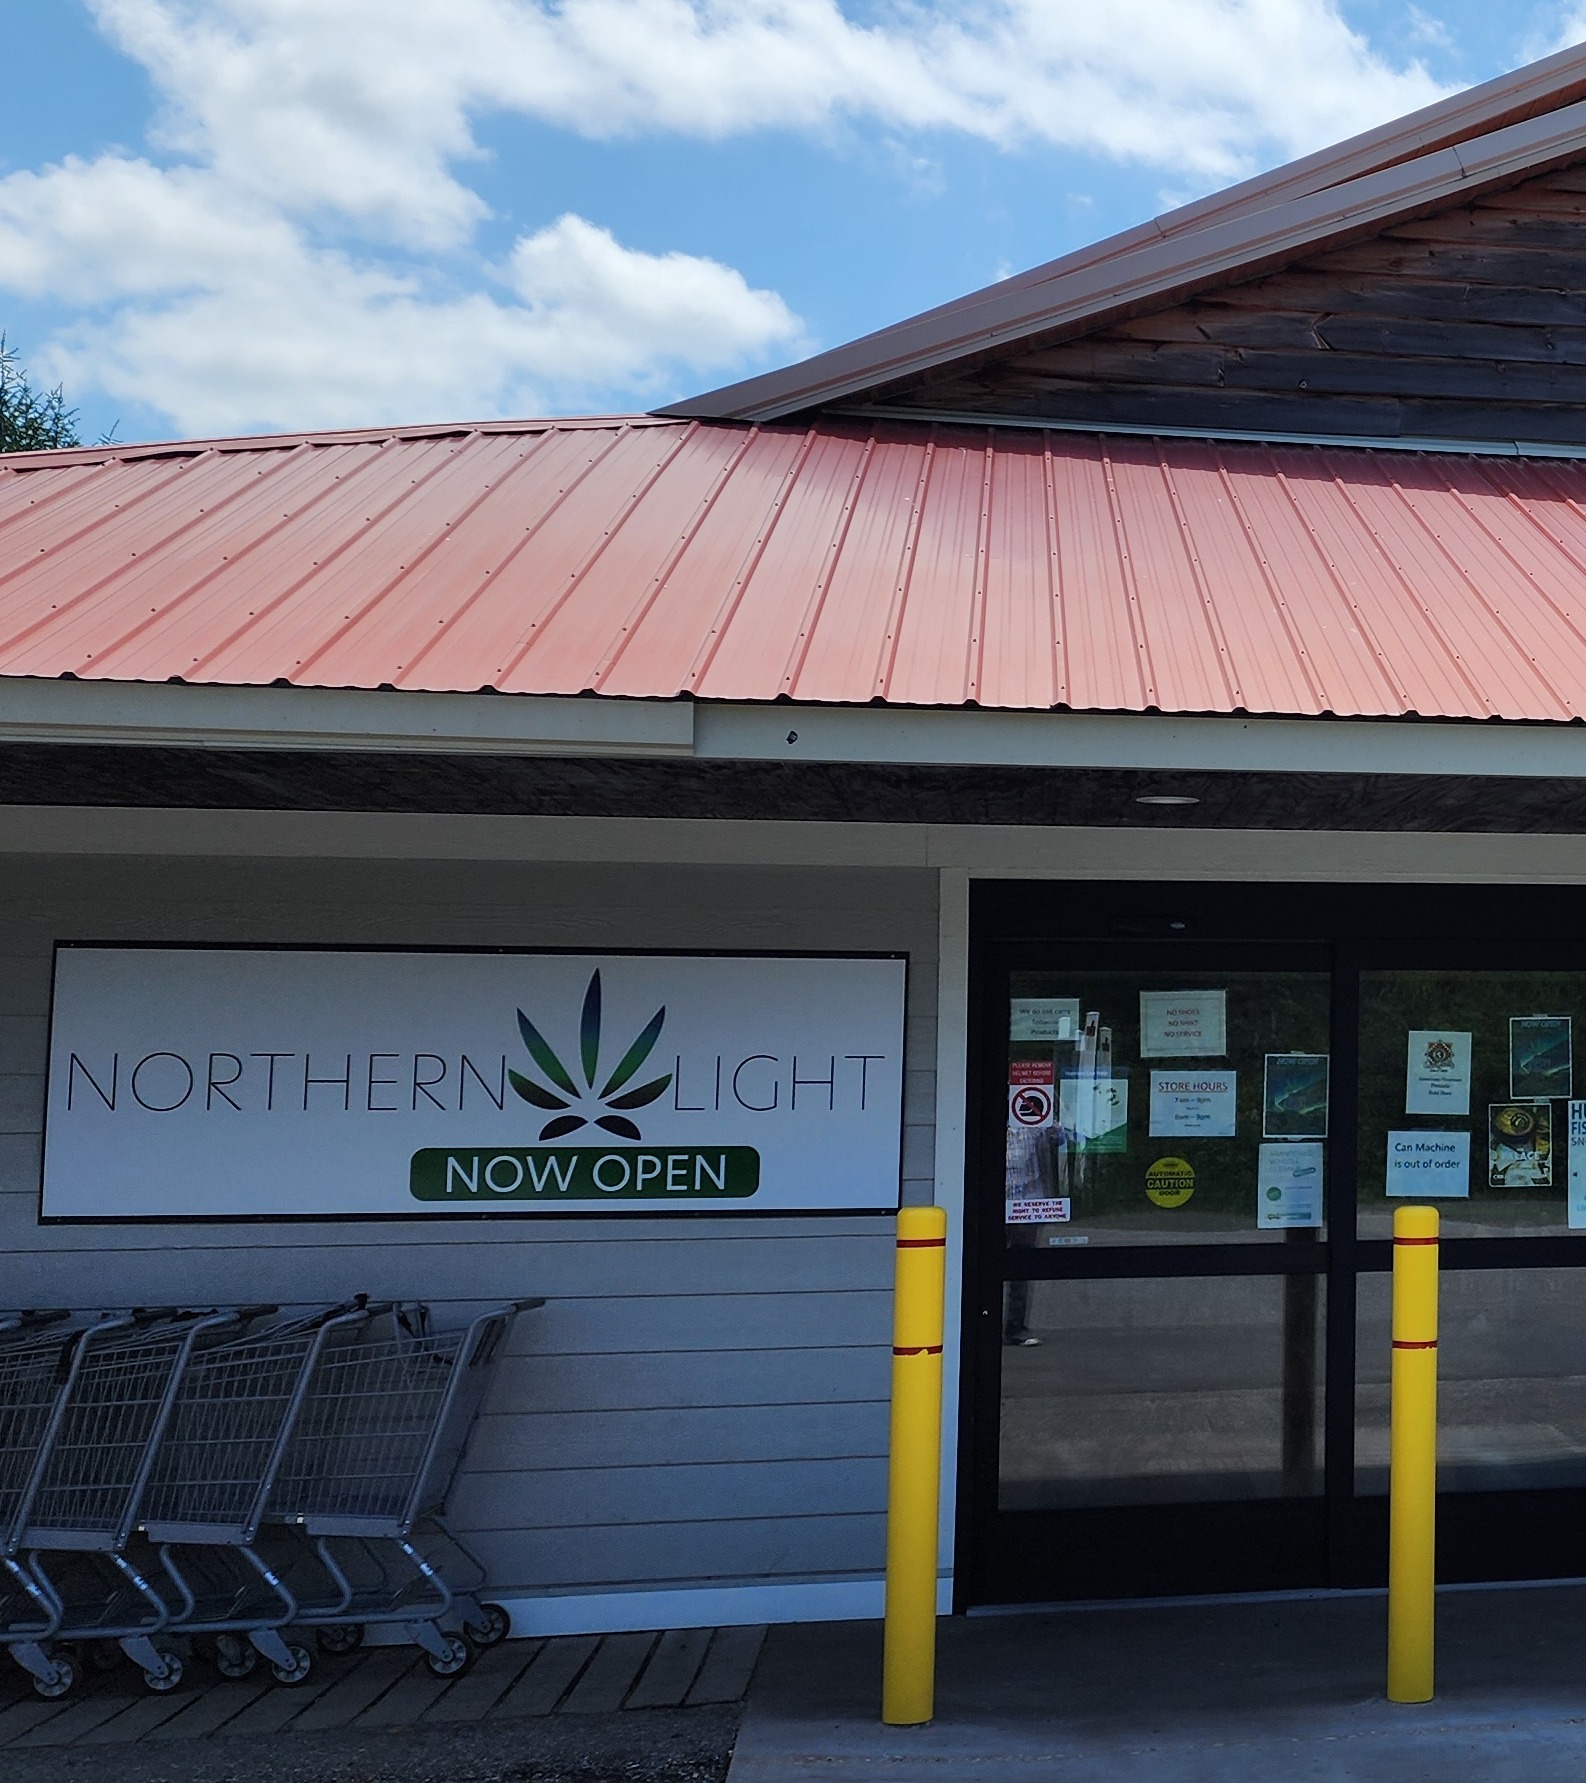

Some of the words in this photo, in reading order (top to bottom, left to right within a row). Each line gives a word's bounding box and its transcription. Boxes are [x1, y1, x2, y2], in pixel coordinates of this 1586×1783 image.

[66, 1050, 507, 1113] NORTHERN
[673, 1053, 886, 1114] LIGHT
[1158, 1081, 1190, 1091] STORE
[1193, 1081, 1228, 1091] HOURS
[1395, 1143, 1413, 1152] Can
[1415, 1143, 1456, 1152] Machine
[1394, 1159, 1402, 1168] is
[1404, 1160, 1420, 1168] out
[1422, 1159, 1433, 1168] of
[1434, 1159, 1460, 1168] order
[445, 1154, 577, 1195] NOW
[591, 1153, 727, 1192] OPEN
[1147, 1179, 1194, 1188] CAUTION
